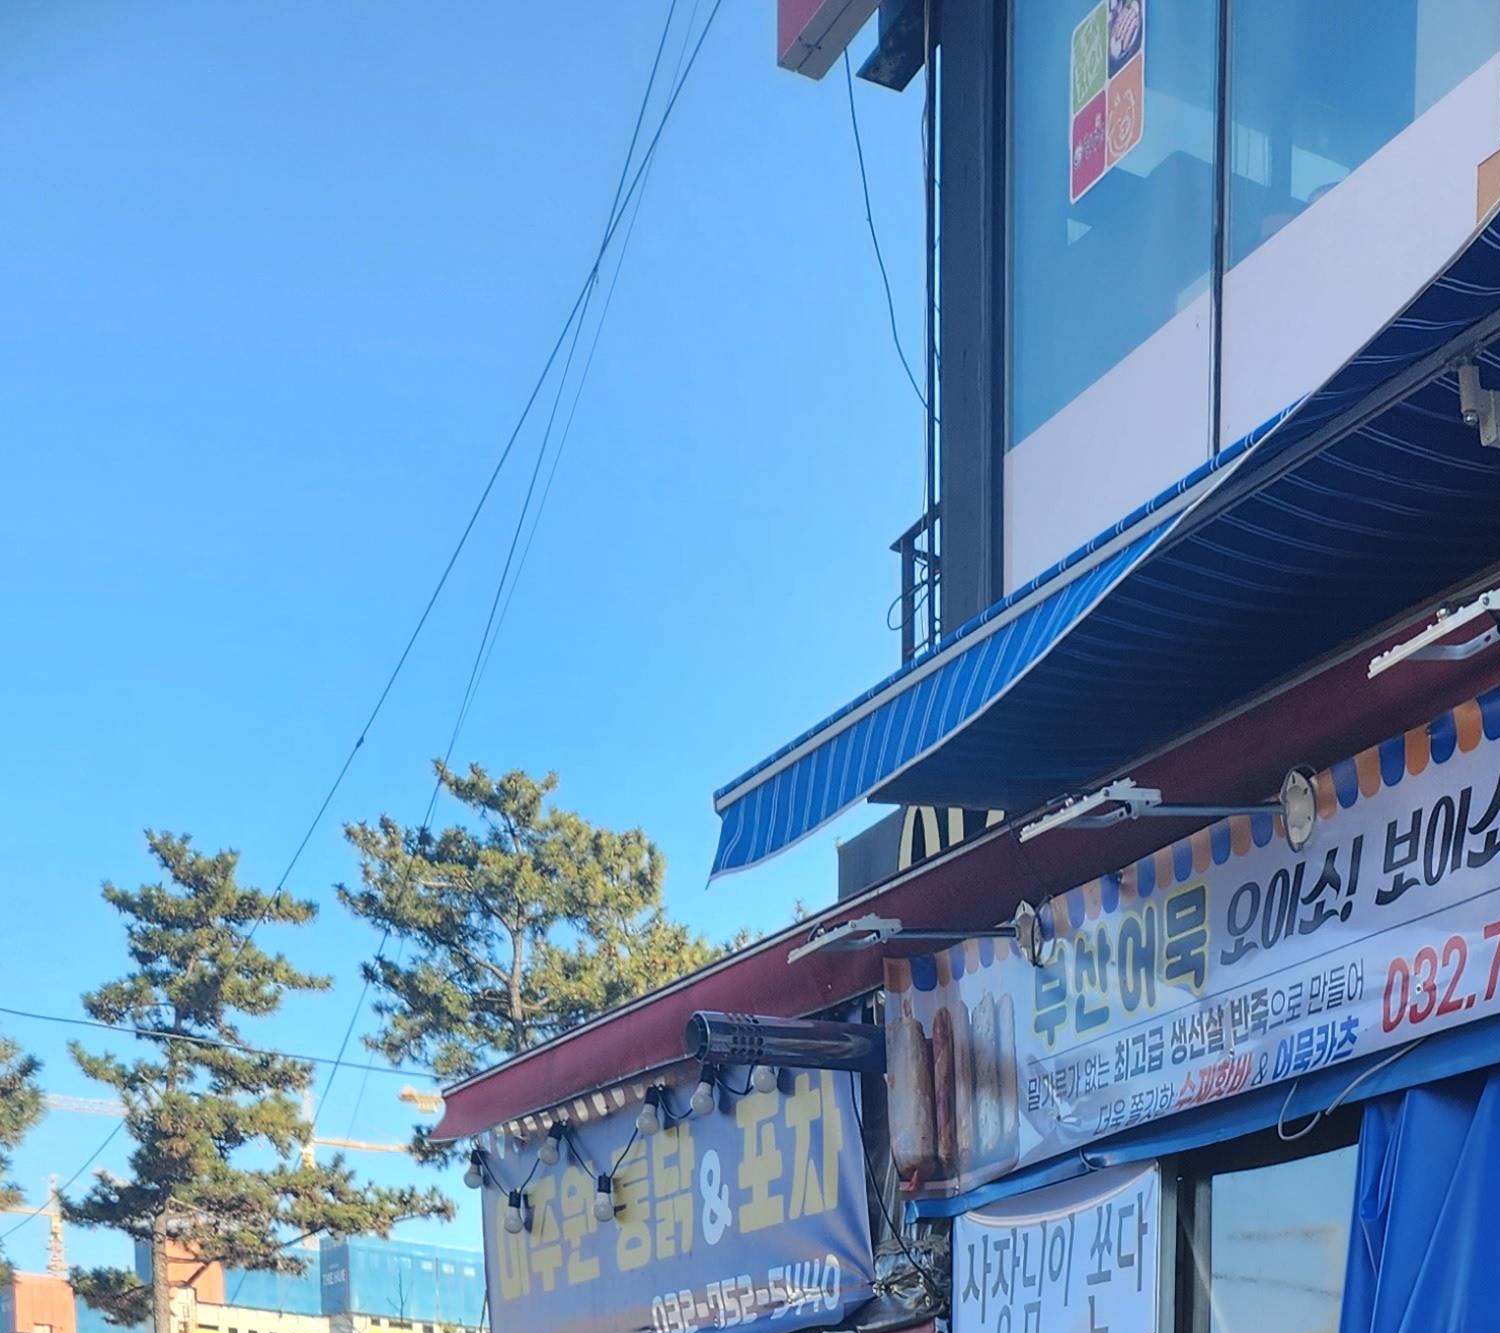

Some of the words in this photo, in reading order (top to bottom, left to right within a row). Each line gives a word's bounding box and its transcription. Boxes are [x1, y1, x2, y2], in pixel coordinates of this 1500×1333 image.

[1031, 883, 1210, 1050] 부산어묵
[1220, 834, 1363, 966] 오이소!
[1028, 1061, 1081, 1112] 밀가루가
[1084, 1055, 1111, 1094] 없는
[1114, 1026, 1164, 1083] 최고급
[1171, 1005, 1225, 1065] 생선살
[1230, 982, 1303, 1046] 반죽으로
[1308, 958, 1364, 1016] 만들어
[1174, 1051, 1254, 1111] 수제핫바
[1252, 1051, 1269, 1085] &
[1272, 1015, 1359, 1081] 어묵카츠
